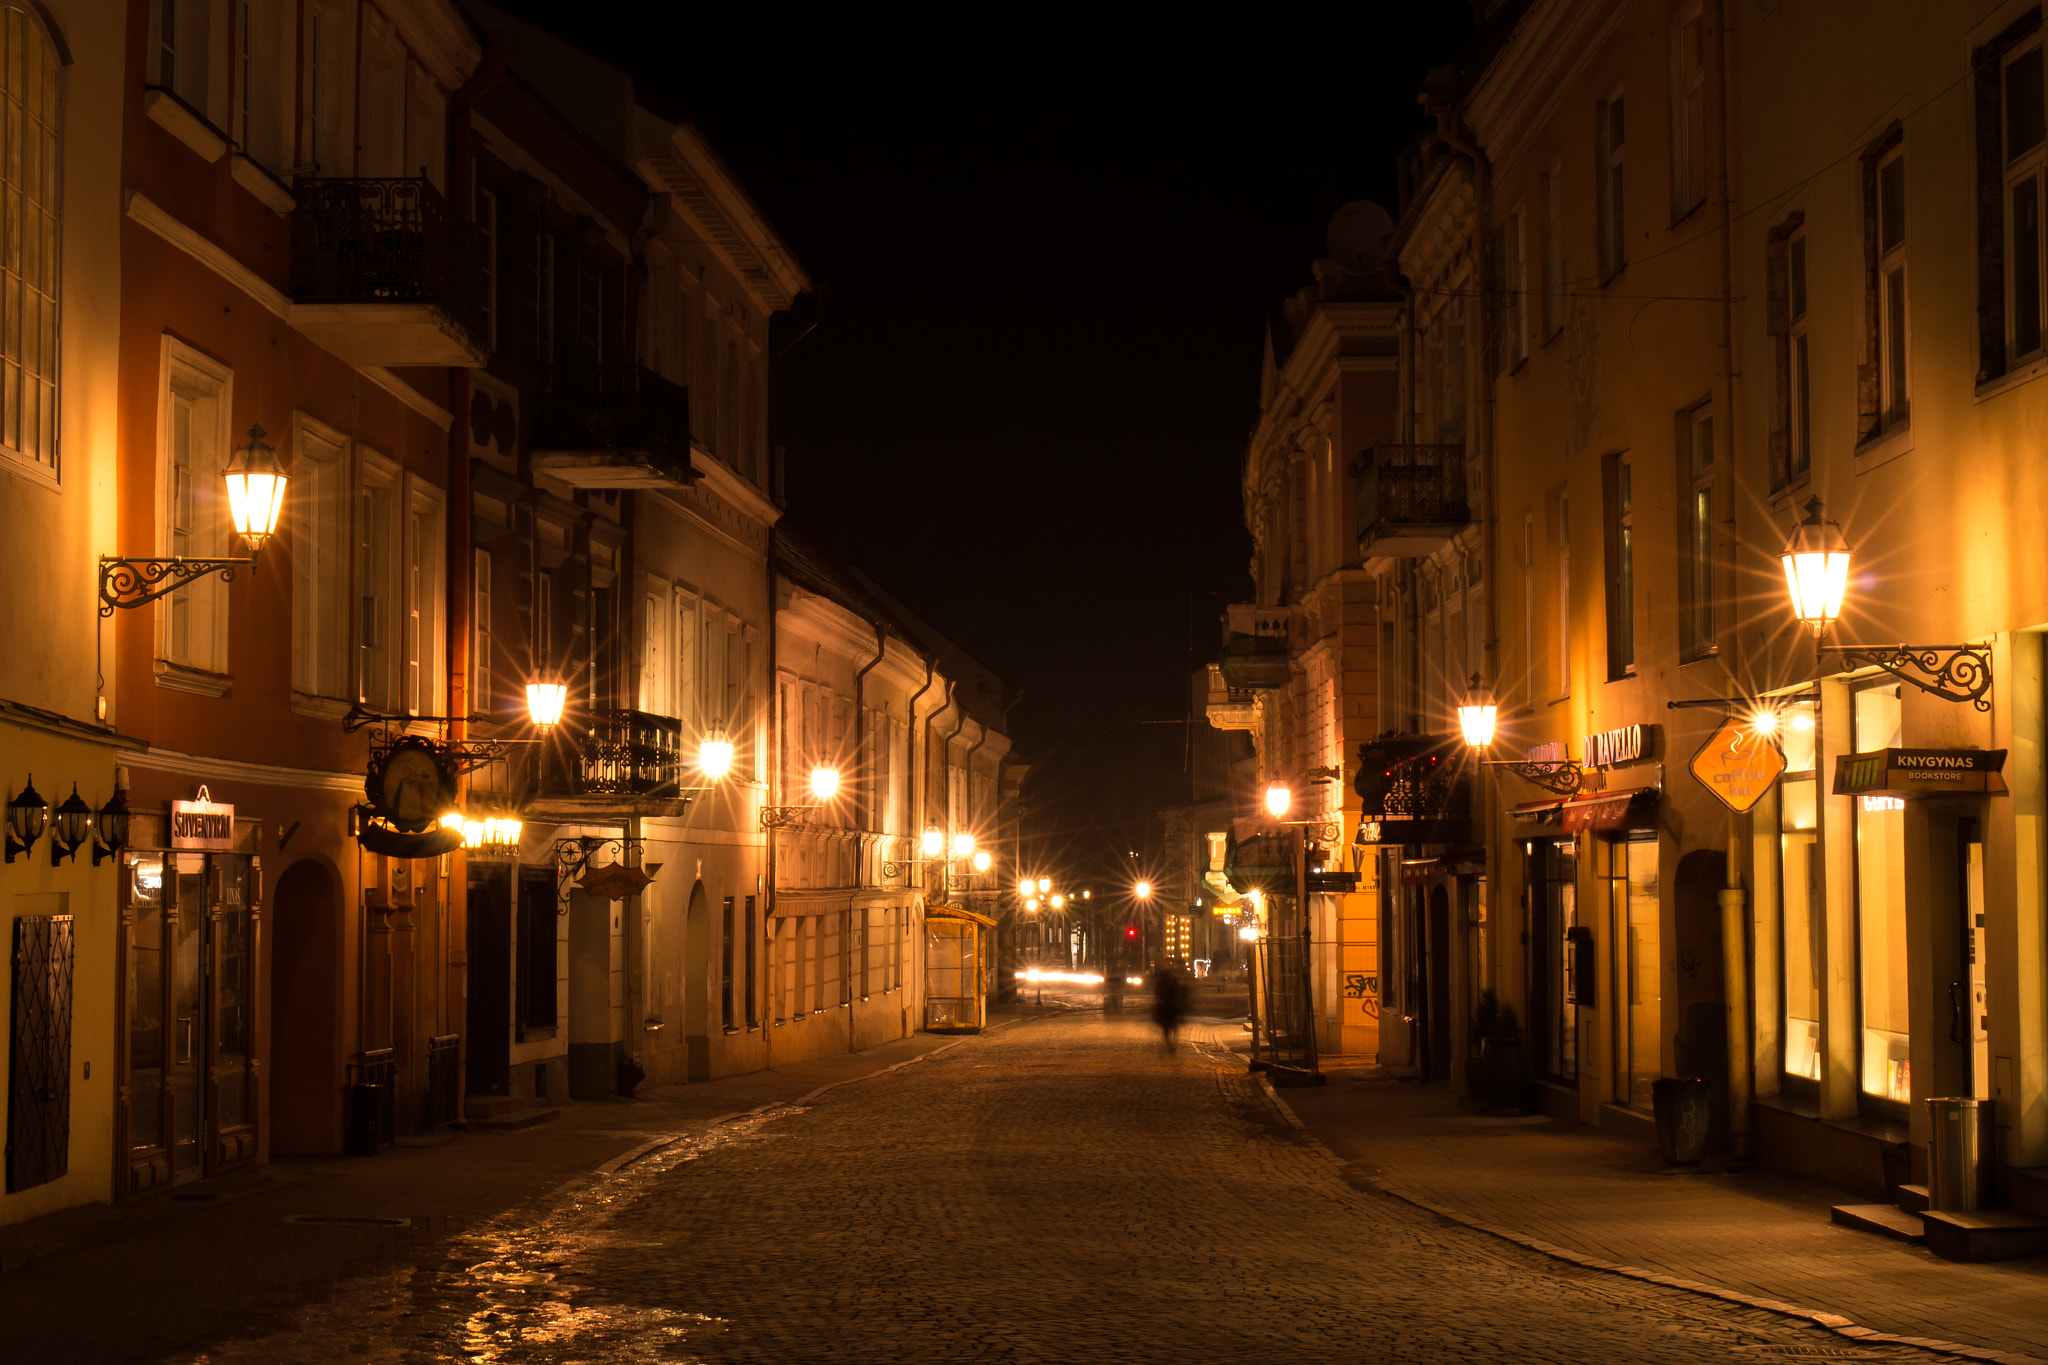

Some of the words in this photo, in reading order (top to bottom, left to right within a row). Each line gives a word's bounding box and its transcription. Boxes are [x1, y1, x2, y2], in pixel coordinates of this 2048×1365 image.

[1583, 735, 1594, 768] DI
[1597, 723, 1641, 766] RAVELLO
[1897, 755, 1974, 768] KNYGYNAS
[1713, 769, 1766, 784] coffee
[1908, 771, 1963, 780] BOOKSTORE
[1729, 783, 1753, 797] inn
[174, 811, 231, 839] SUVENYRAI
